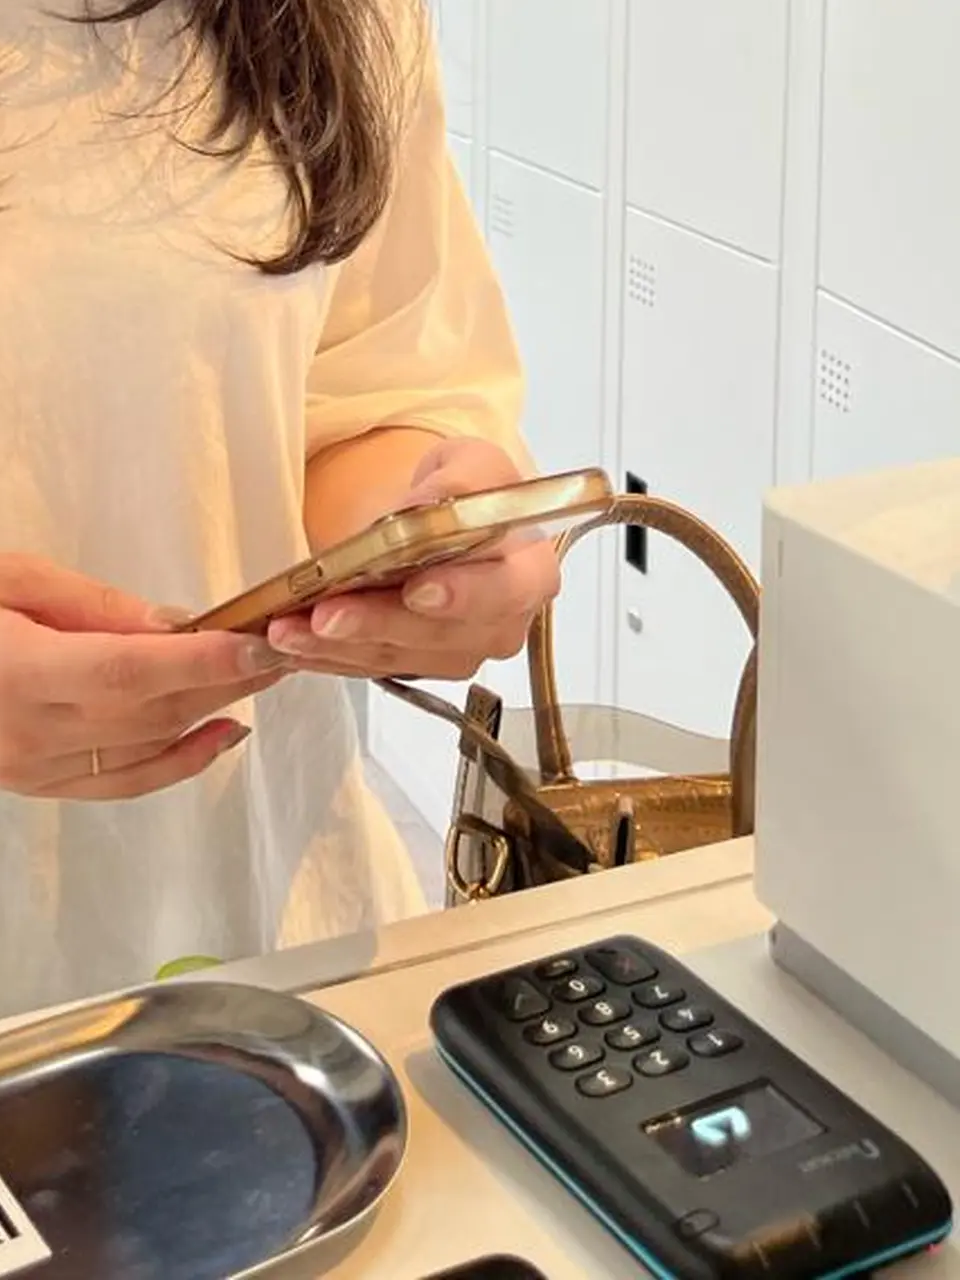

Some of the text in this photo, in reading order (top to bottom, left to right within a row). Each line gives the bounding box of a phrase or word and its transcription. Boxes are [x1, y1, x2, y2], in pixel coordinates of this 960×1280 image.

[568, 979, 585, 993] 0
[542, 984, 669, 1035] 7 8 9
[623, 1024, 642, 1040] 5
[567, 1044, 584, 1060] 6
[596, 1033, 724, 1087] 1 2 3
